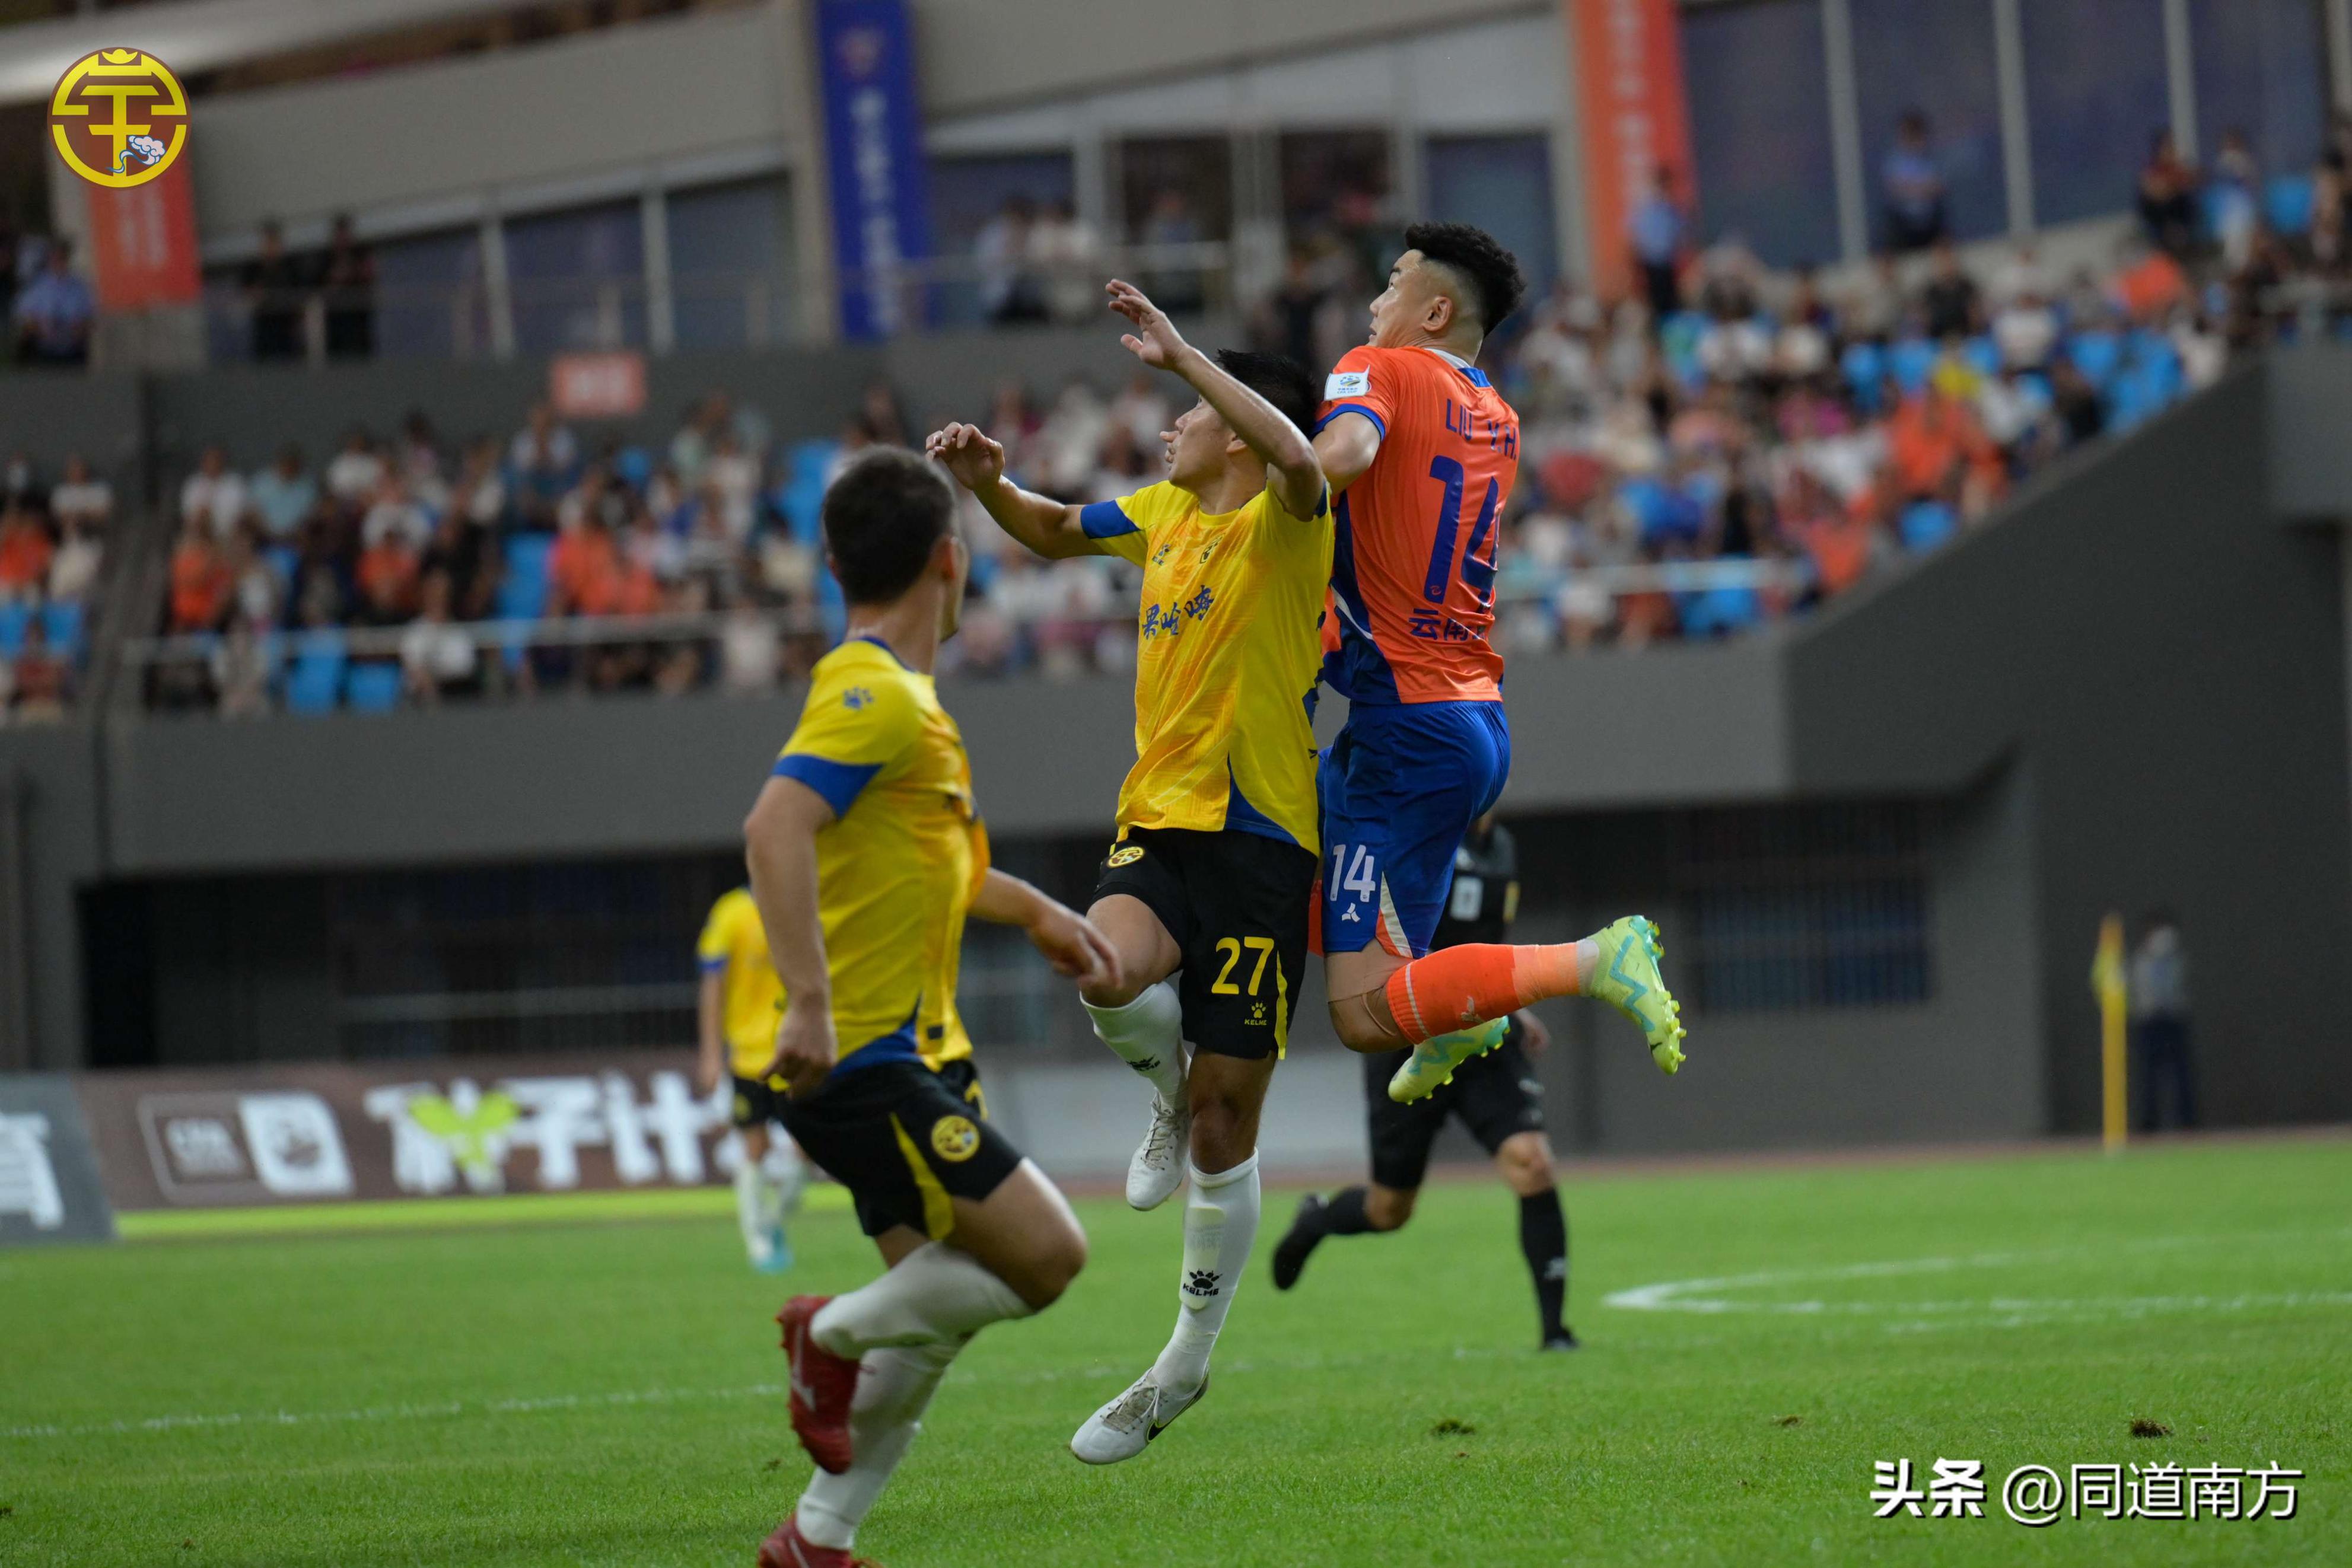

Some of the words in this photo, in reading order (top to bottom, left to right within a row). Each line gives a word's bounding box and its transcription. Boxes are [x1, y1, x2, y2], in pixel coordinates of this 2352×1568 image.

[1446, 398, 1472, 441] LIU
[1424, 455, 1498, 608] 14
[1330, 844, 1376, 902] 14
[1211, 936, 1274, 996] 27
[1183, 1282, 1220, 1297] KELME
